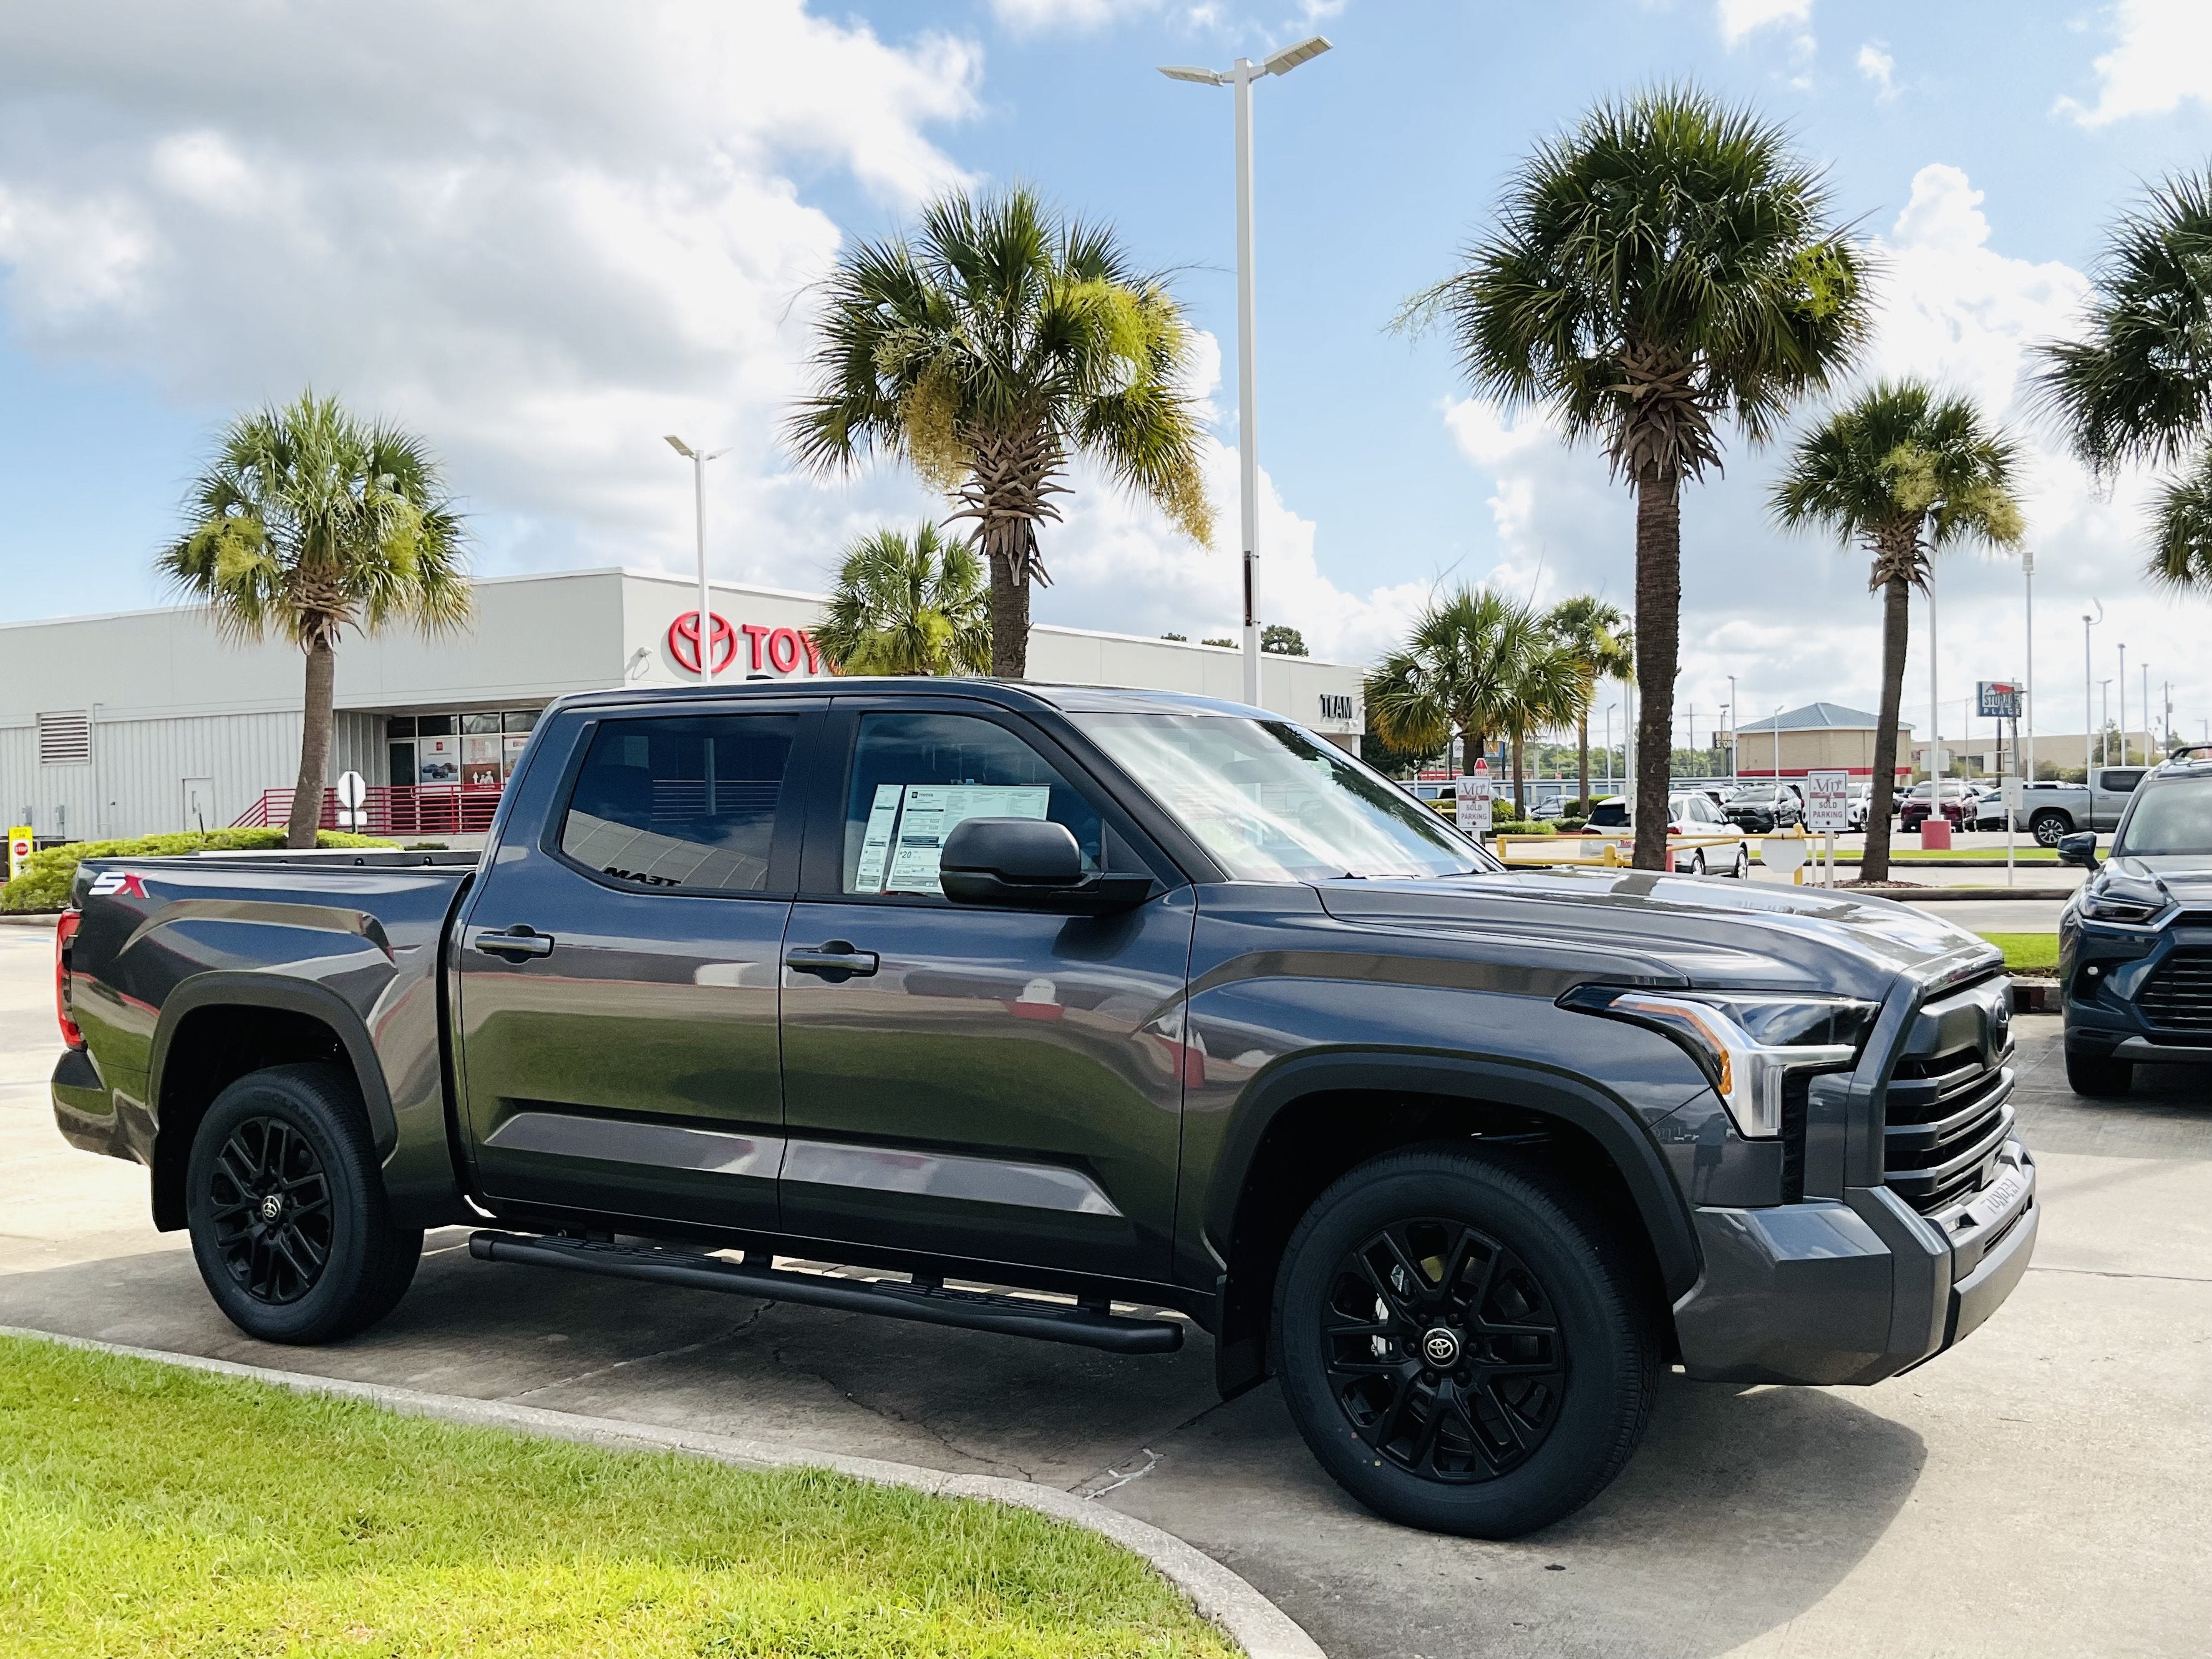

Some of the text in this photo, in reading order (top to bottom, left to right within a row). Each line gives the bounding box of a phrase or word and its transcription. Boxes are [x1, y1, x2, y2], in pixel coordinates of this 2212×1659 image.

[742, 624, 837, 675] TOY
[1319, 694, 1352, 719] TEAM
[1715, 740, 1733, 748] STOR
